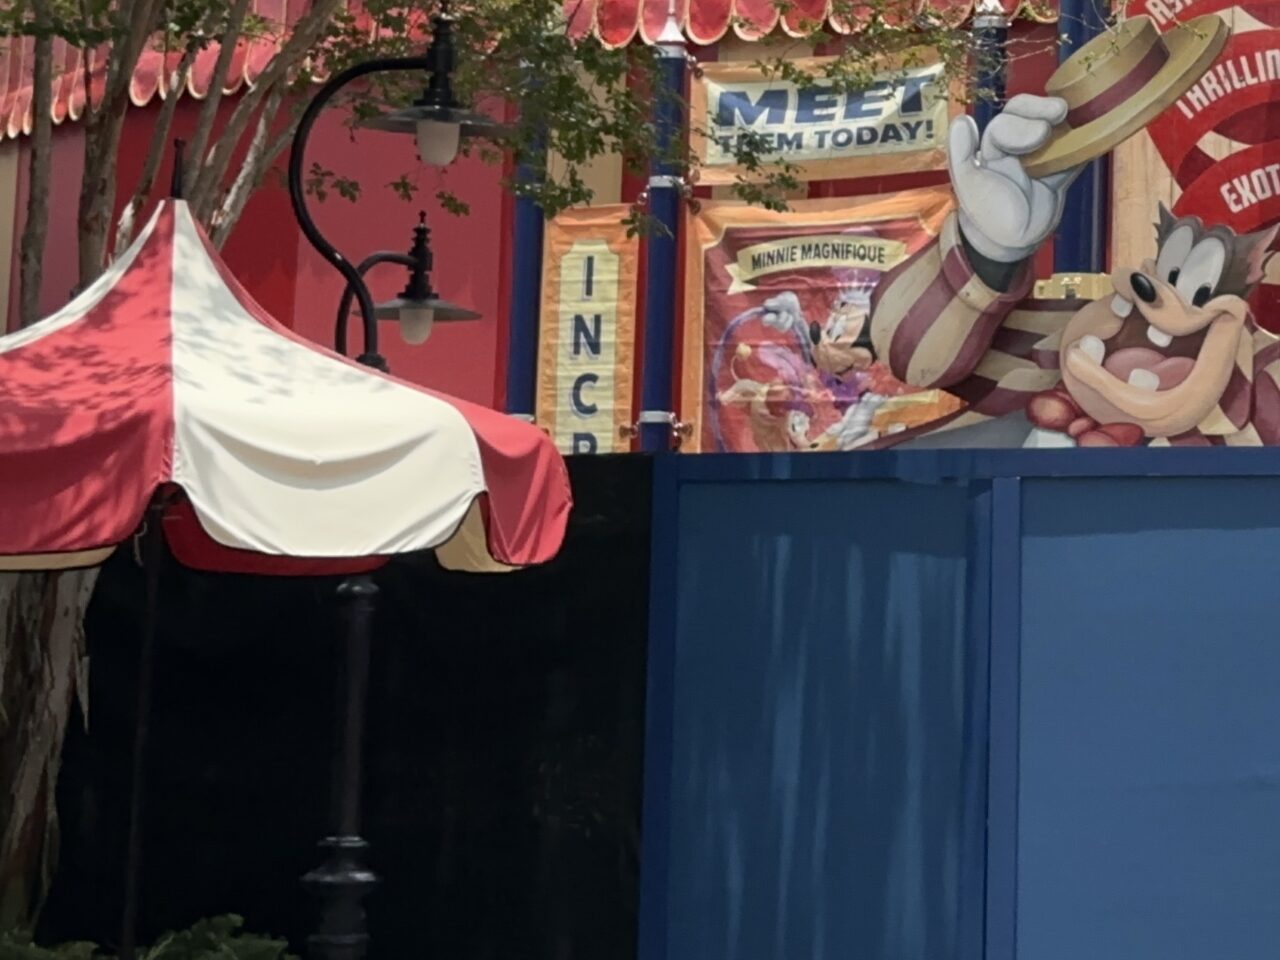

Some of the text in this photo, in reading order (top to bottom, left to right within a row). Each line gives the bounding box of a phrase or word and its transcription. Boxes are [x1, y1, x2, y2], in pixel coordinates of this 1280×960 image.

[718, 73, 937, 127] MEET
[814, 119, 934, 151] TODAY!
[751, 241, 886, 272] MINNIE MAGNIFIQUE
